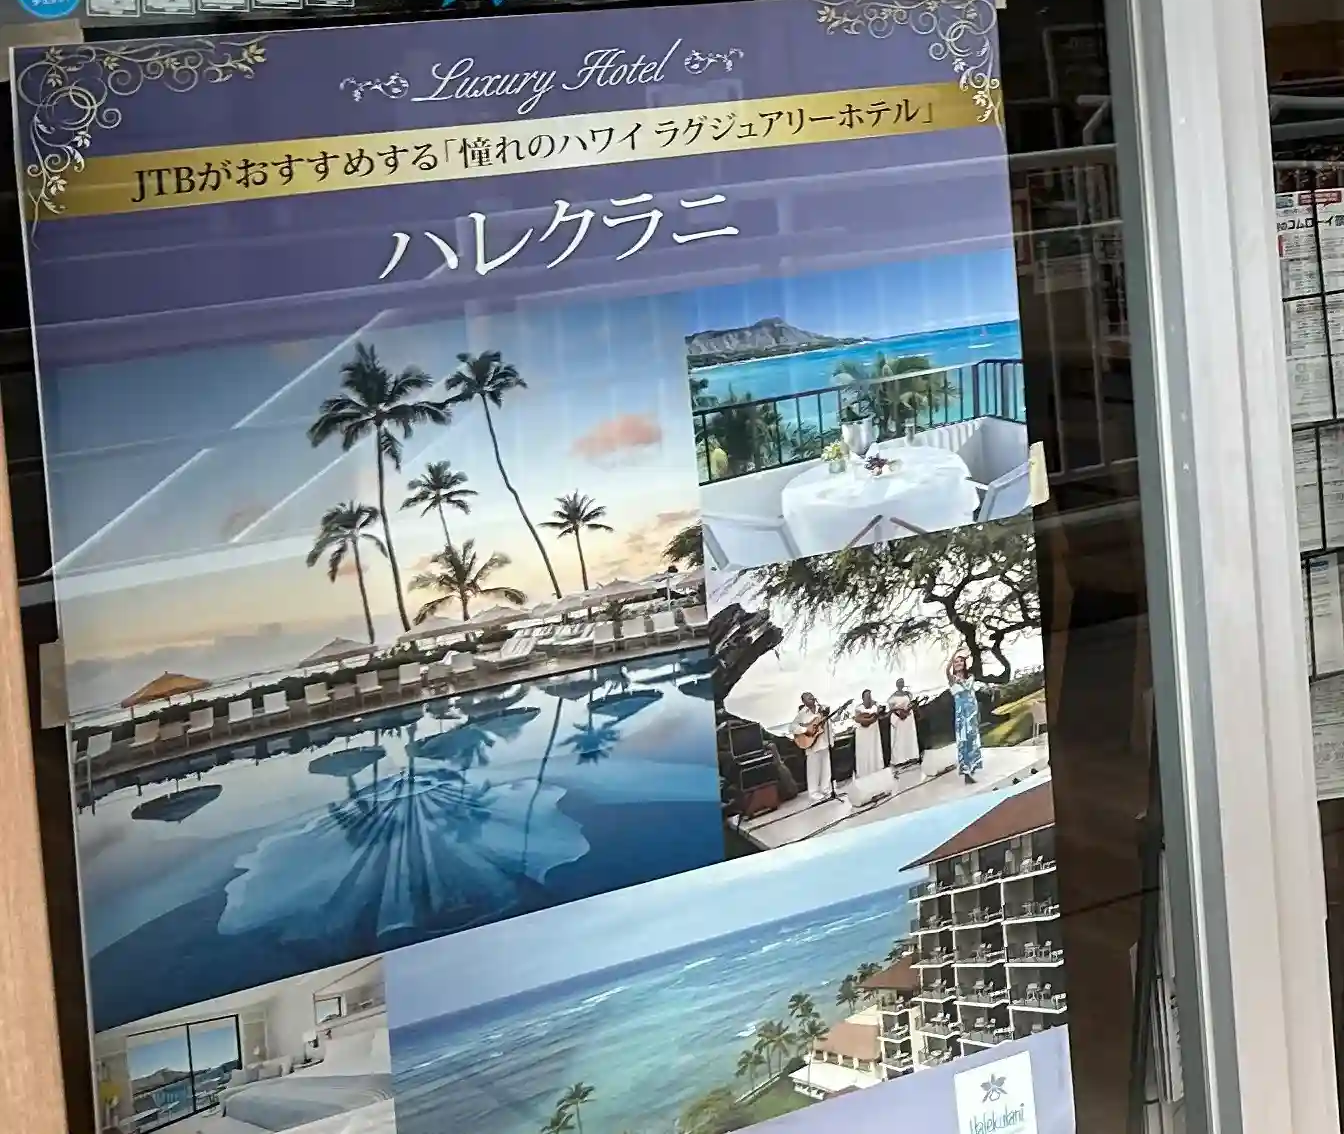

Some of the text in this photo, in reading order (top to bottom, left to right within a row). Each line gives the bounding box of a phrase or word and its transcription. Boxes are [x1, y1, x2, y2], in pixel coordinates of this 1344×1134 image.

[411, 38, 682, 115] Luxury Hotel
[379, 192, 740, 283] ハレクラニ
